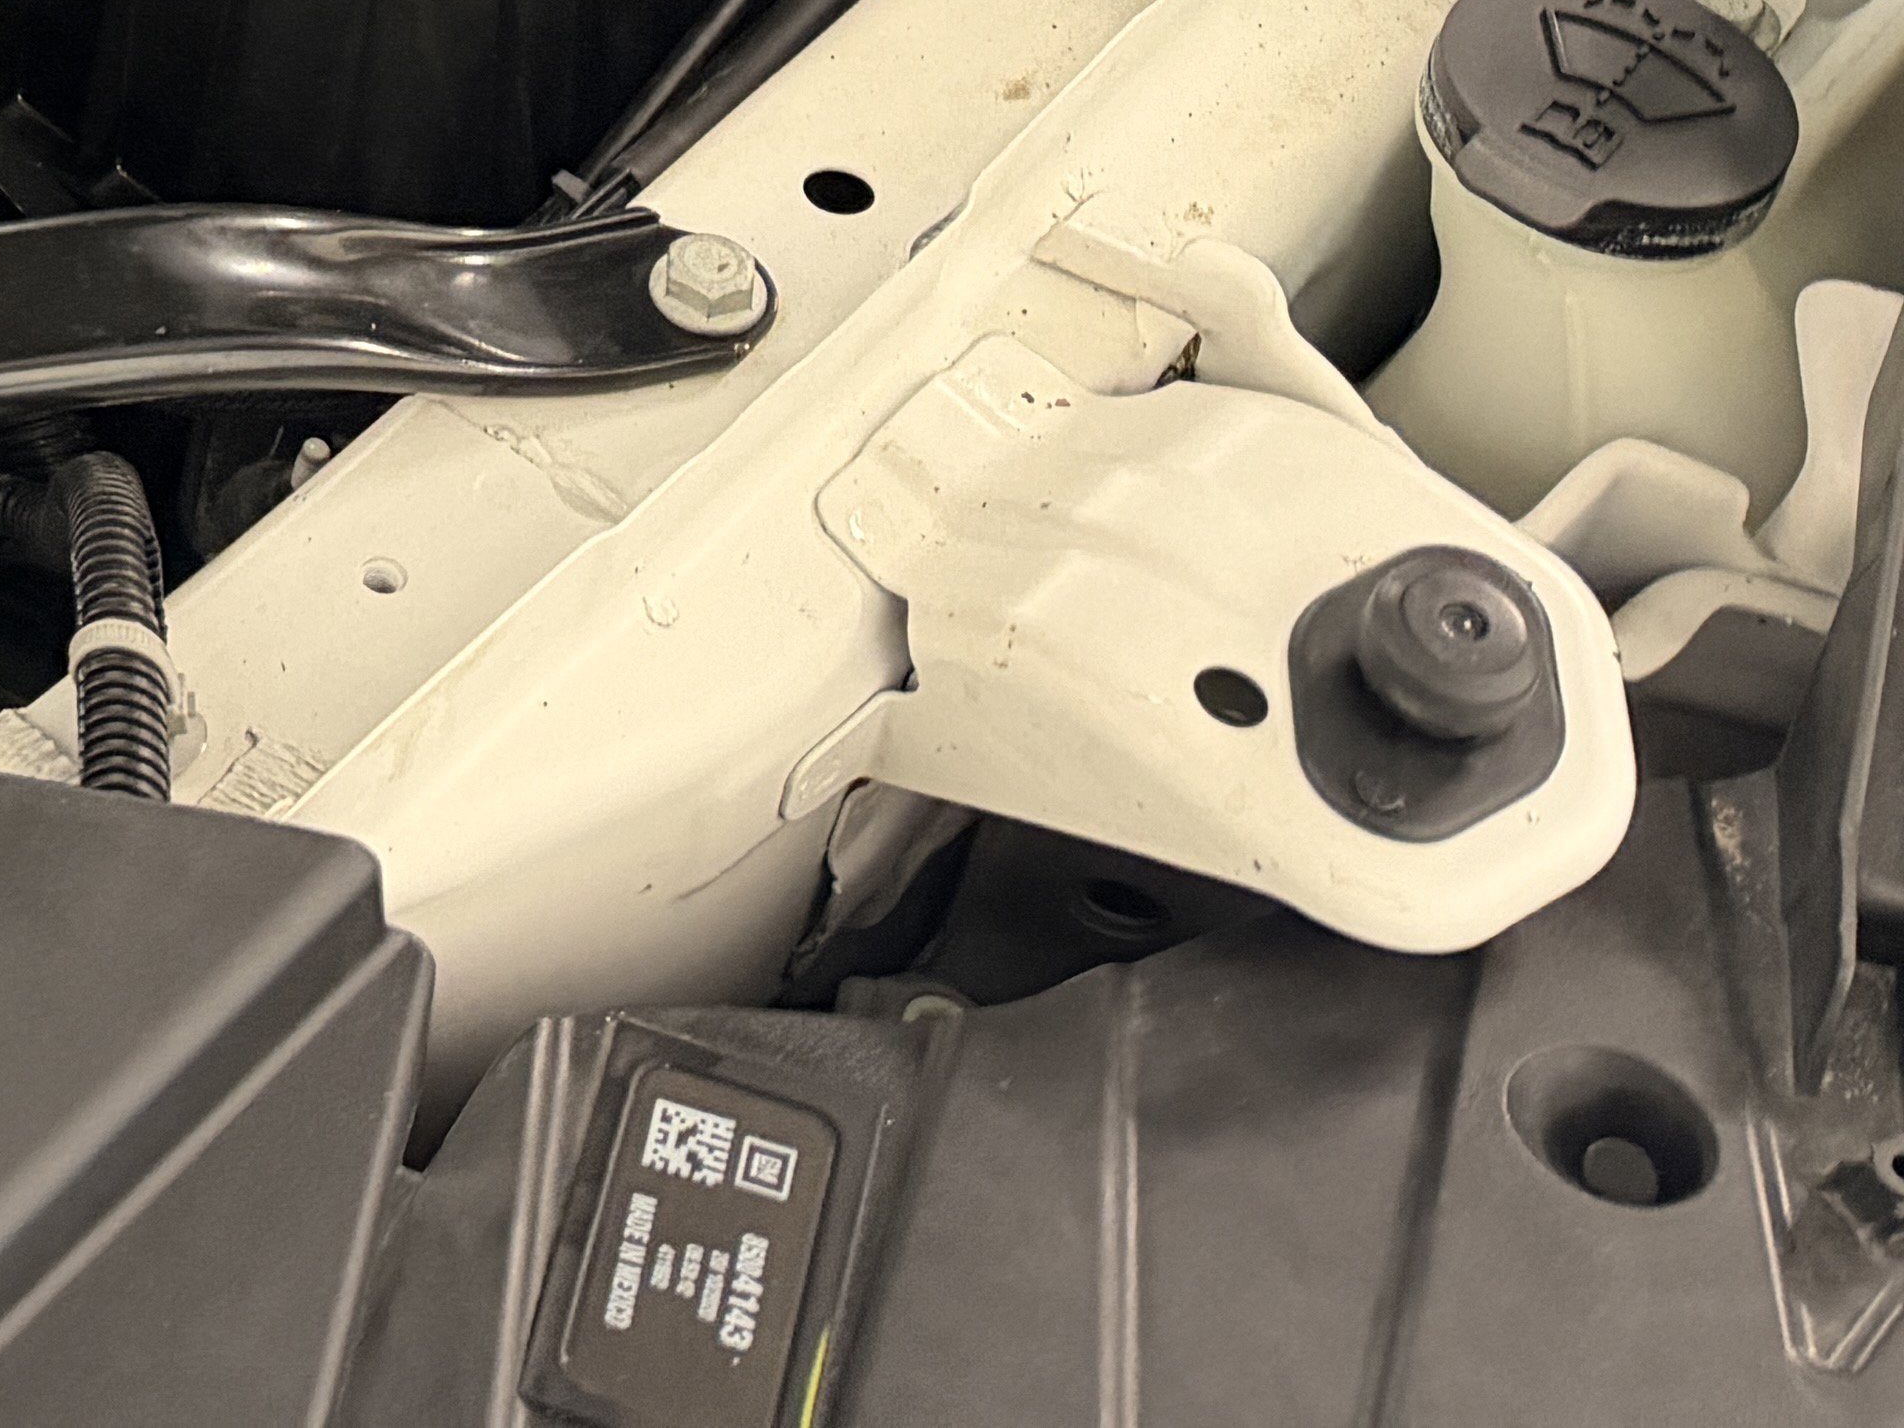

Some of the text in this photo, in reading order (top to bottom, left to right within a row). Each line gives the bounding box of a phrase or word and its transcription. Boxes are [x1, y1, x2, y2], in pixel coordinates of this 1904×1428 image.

[604, 1192, 658, 1330] MADE IN MEXICO
